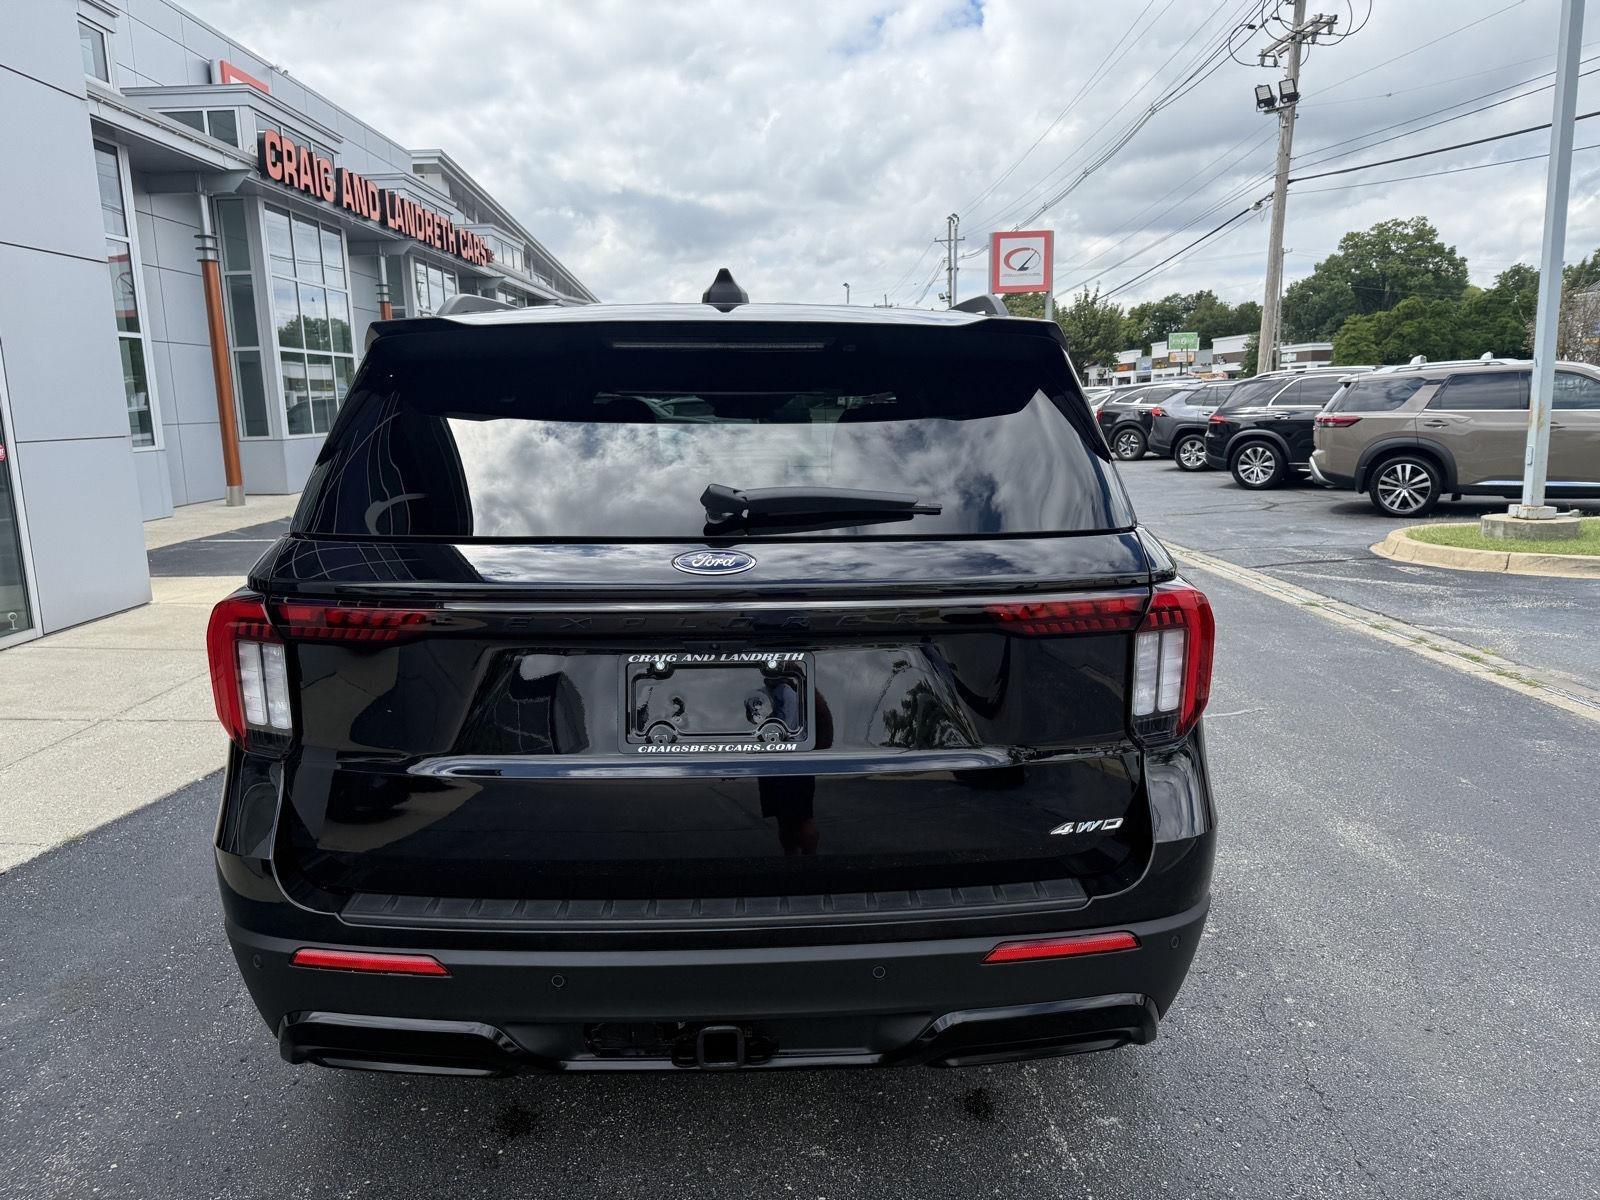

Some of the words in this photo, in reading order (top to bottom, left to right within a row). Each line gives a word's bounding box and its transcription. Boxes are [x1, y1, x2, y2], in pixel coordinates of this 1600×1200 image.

[263, 129, 336, 203] CRAIG
[341, 167, 381, 223] AND
[384, 189, 457, 256] LANDRETH
[459, 228, 487, 267] CARS
[691, 553, 736, 567] Ford
[505, 614, 920, 630] EXPLORER
[628, 653, 678, 663] CRAIG
[681, 653, 716, 662] AND
[720, 652, 805, 662] LANDRETH
[637, 743, 798, 753] CRAIGSBESTCARS.COM
[1048, 817, 1124, 835] 4WD
